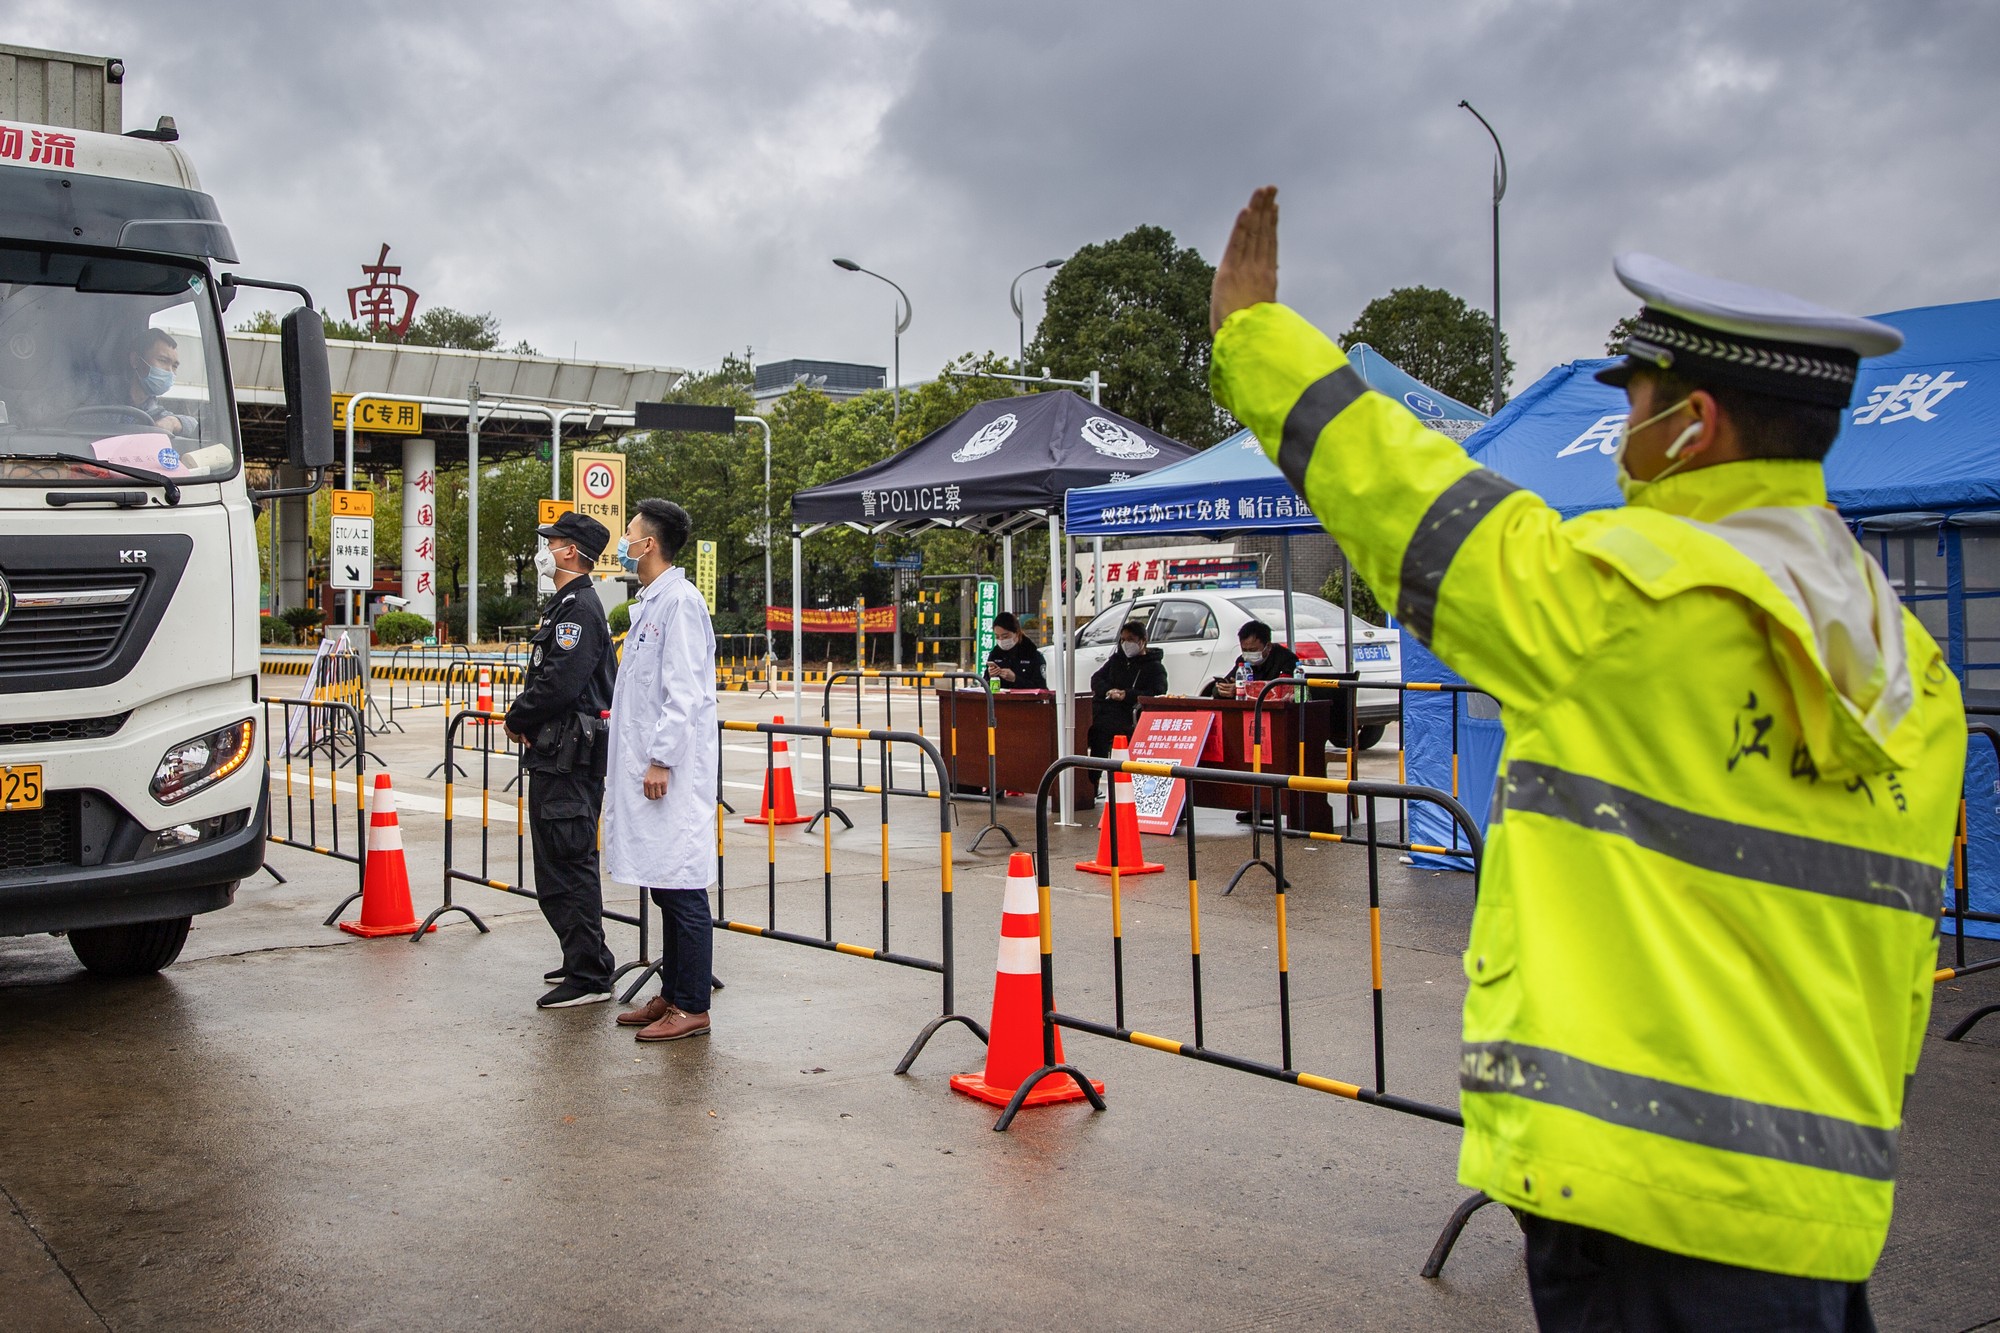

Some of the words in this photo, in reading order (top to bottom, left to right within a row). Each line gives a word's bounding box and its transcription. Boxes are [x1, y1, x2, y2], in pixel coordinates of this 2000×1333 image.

[347, 242, 420, 338] 南
[1852, 371, 1968, 425] 救
[590, 471, 610, 488] 20
[340, 496, 348, 510] 5
[580, 503, 619, 517] ETC专用
[1238, 494, 1313, 519] 畅行高速
[547, 506, 555, 519] 5
[336, 526, 369, 540] ETC/人工
[414, 469, 434, 596] 利国利民
[119, 550, 147, 564] KR
[336, 544, 369, 557] 保持车距
[1150, 718, 1193, 731] 温馨提示
[0, 772, 39, 803] 25
